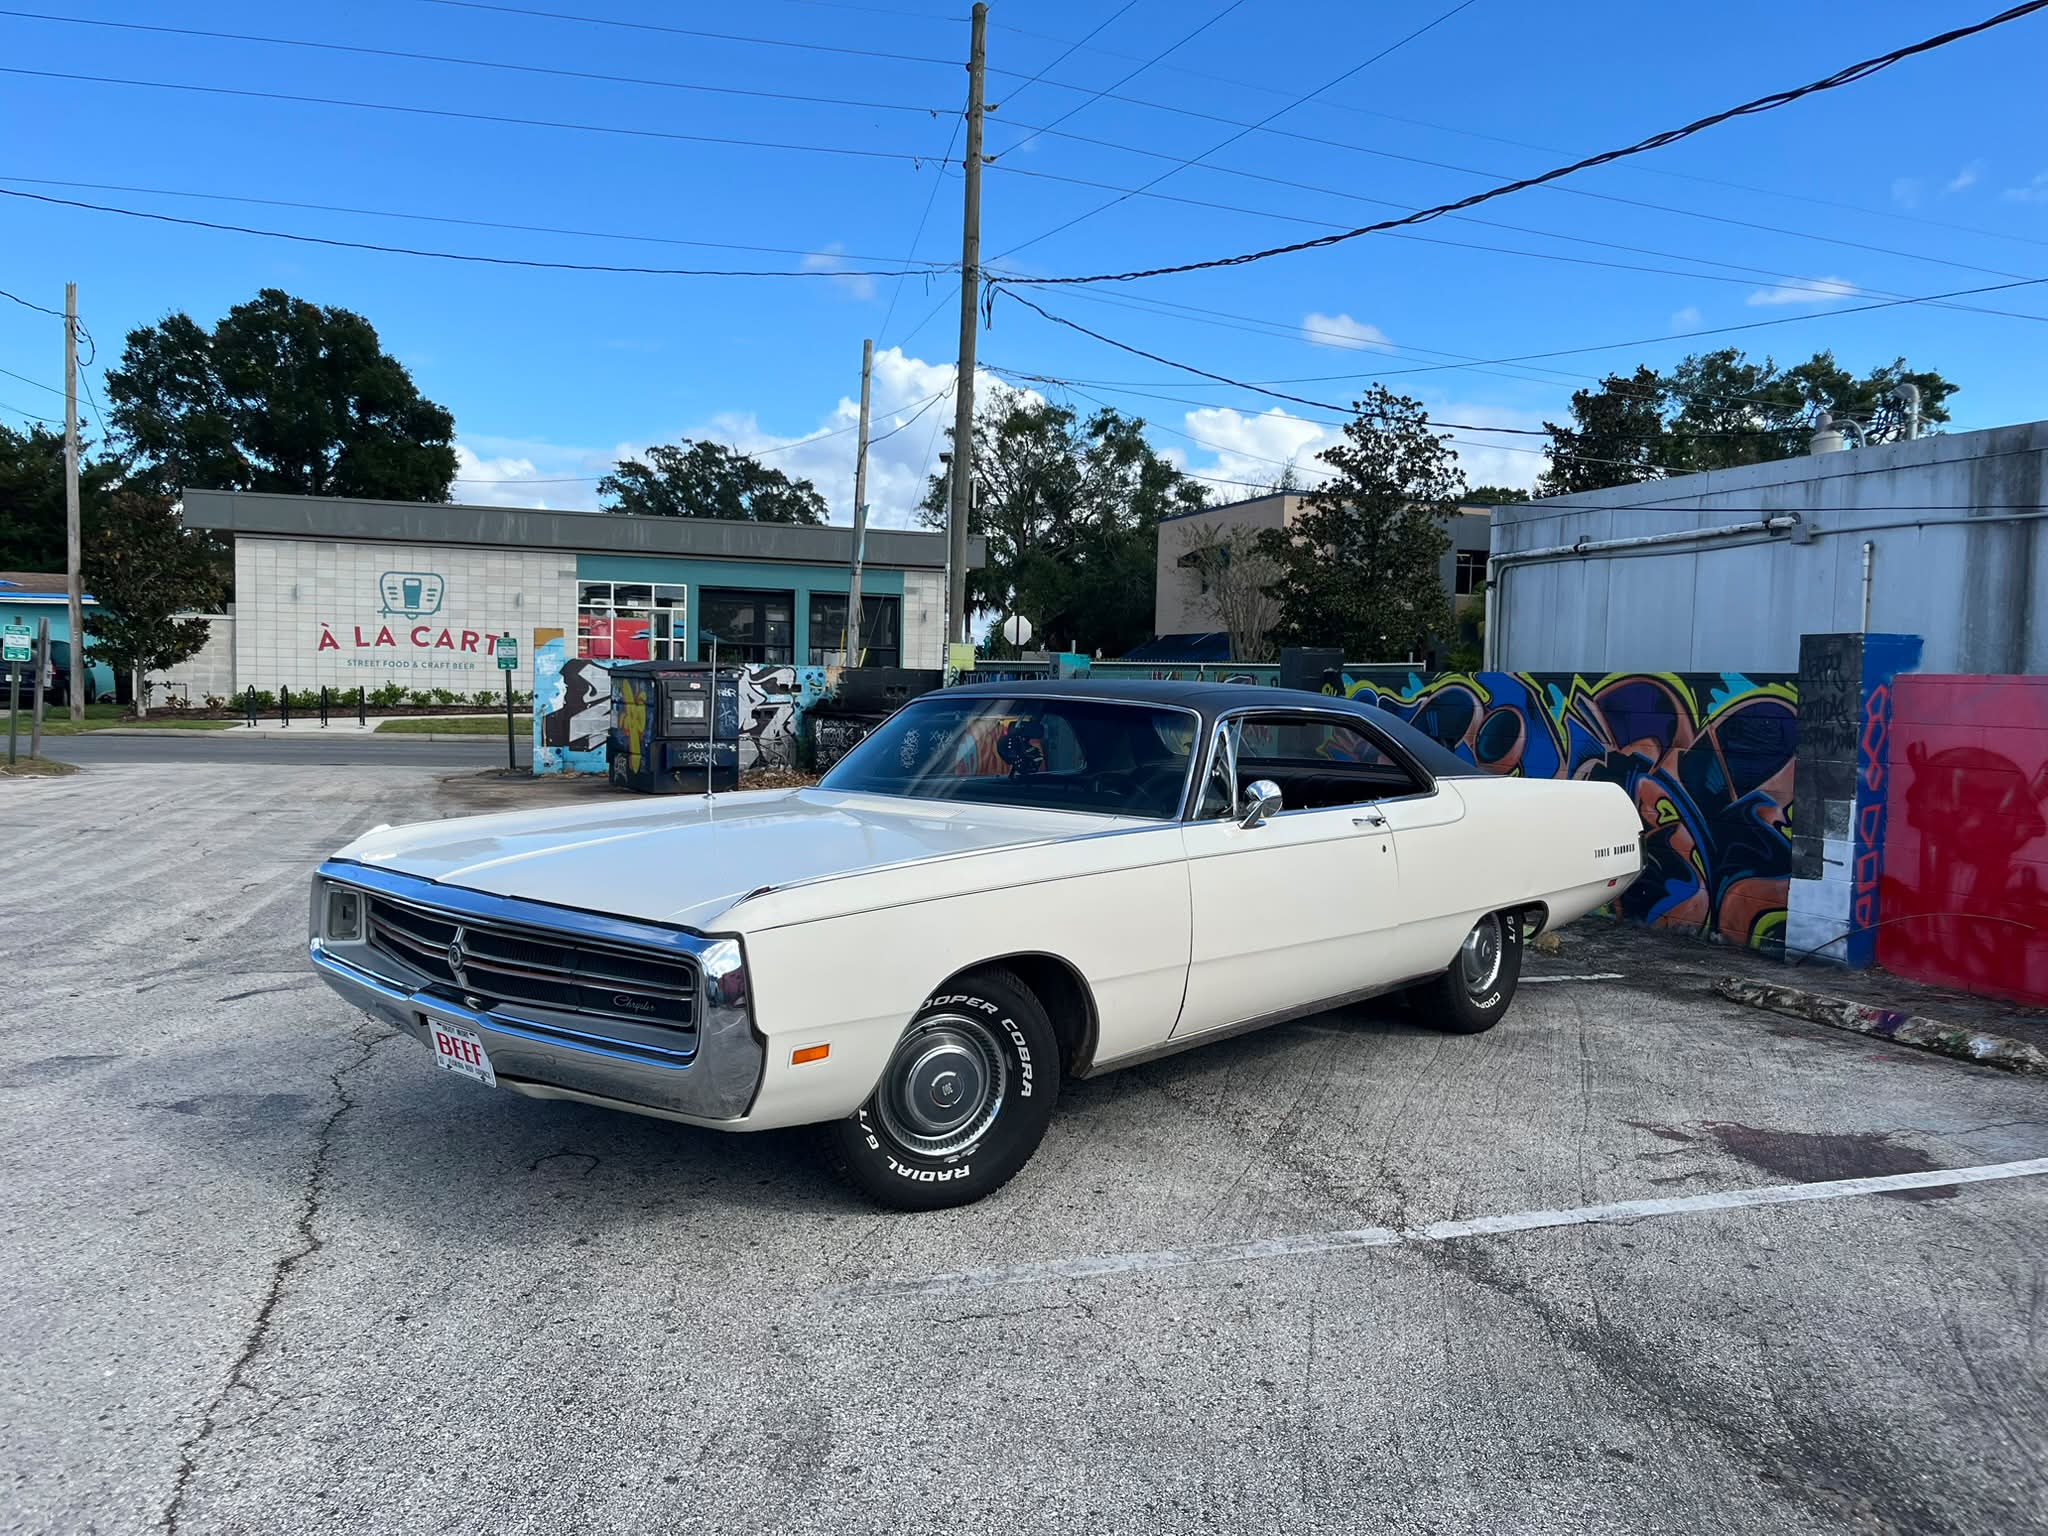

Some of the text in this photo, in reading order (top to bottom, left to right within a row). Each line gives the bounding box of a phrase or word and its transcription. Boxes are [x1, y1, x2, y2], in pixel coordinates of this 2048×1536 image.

[318, 622, 341, 651] À
[354, 625, 397, 647] LA
[347, 659, 381, 668] STREET
[383, 660, 410, 669] FOOD
[412, 661, 419, 669] &
[421, 662, 450, 670] CRAFT
[1506, 915, 1516, 944] G/T
[436, 1031, 482, 1066] BEEF
[1001, 1018, 1033, 1097] COBRA
[859, 1109, 970, 1182] RADIAL G/T
